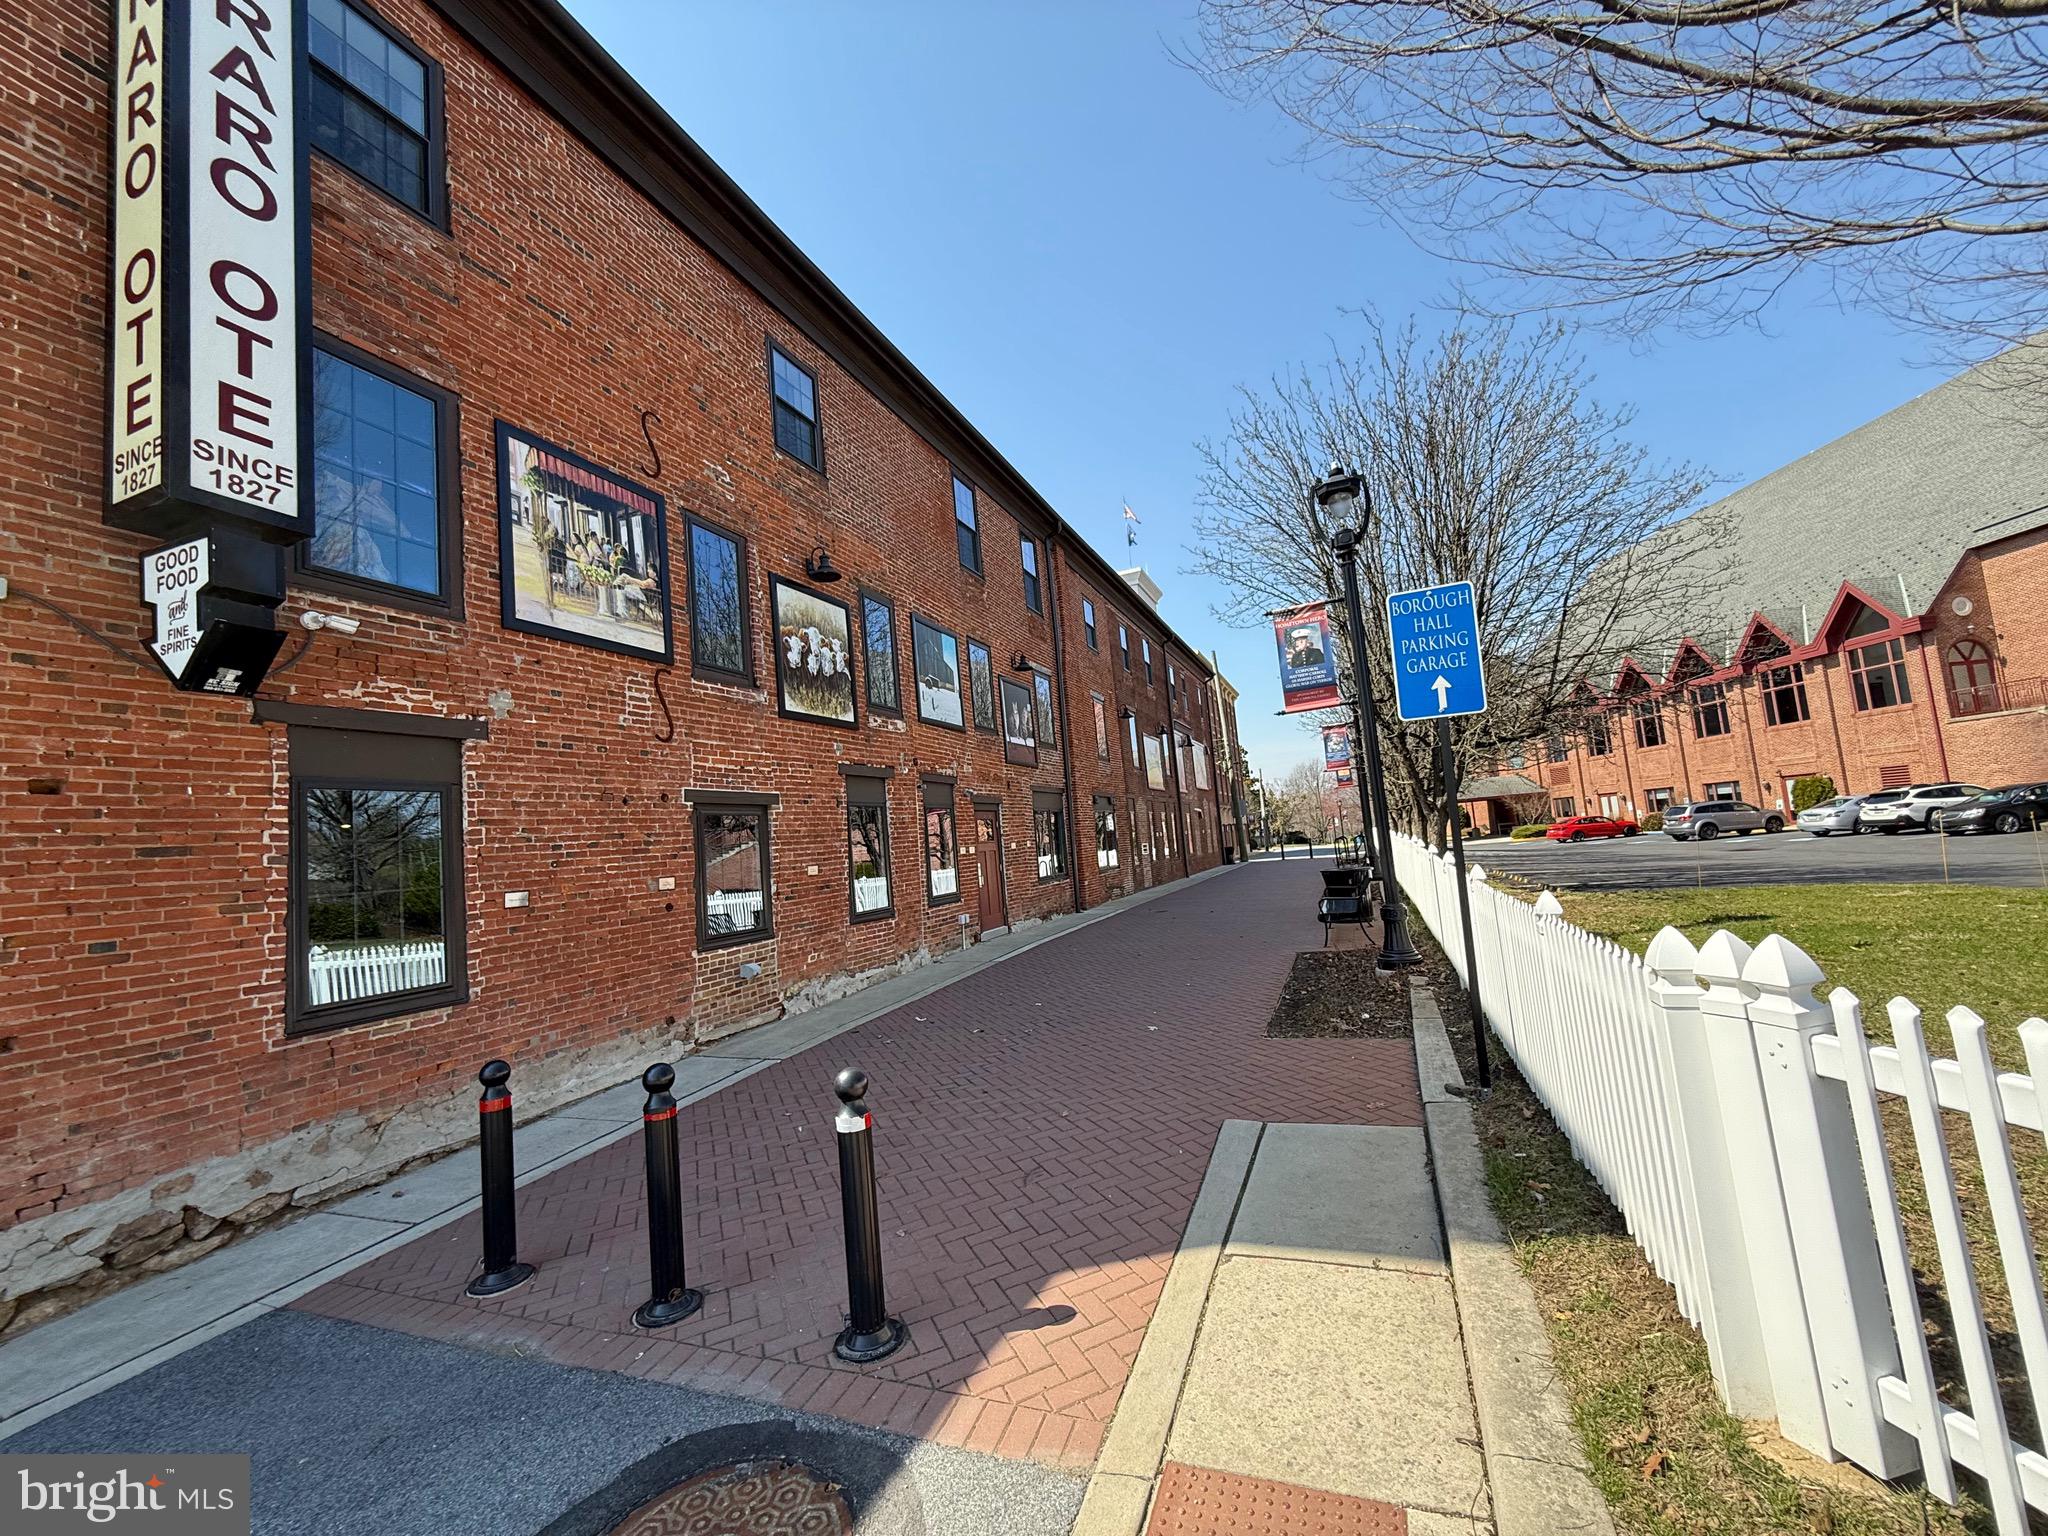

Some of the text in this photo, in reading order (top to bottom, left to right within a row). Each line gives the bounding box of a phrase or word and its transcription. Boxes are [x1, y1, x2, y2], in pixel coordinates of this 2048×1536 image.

[124, 248, 156, 436] OTE
[209, 259, 278, 449] OTE
[115, 436, 162, 474] SINCE
[192, 439, 294, 488] SINCE
[121, 463, 156, 495] 1827
[209, 469, 281, 505] 1827
[155, 545, 199, 573] GOOD
[157, 566, 198, 594] FOOD
[168, 589, 189, 625] and
[1391, 589, 1470, 617] BOROUGH
[167, 624, 189, 641] FINE
[1413, 613, 1453, 633] HALL
[160, 636, 197, 656] SPIRITS
[1401, 631, 1469, 655] PARKING
[1406, 651, 1468, 674] GARAGE
